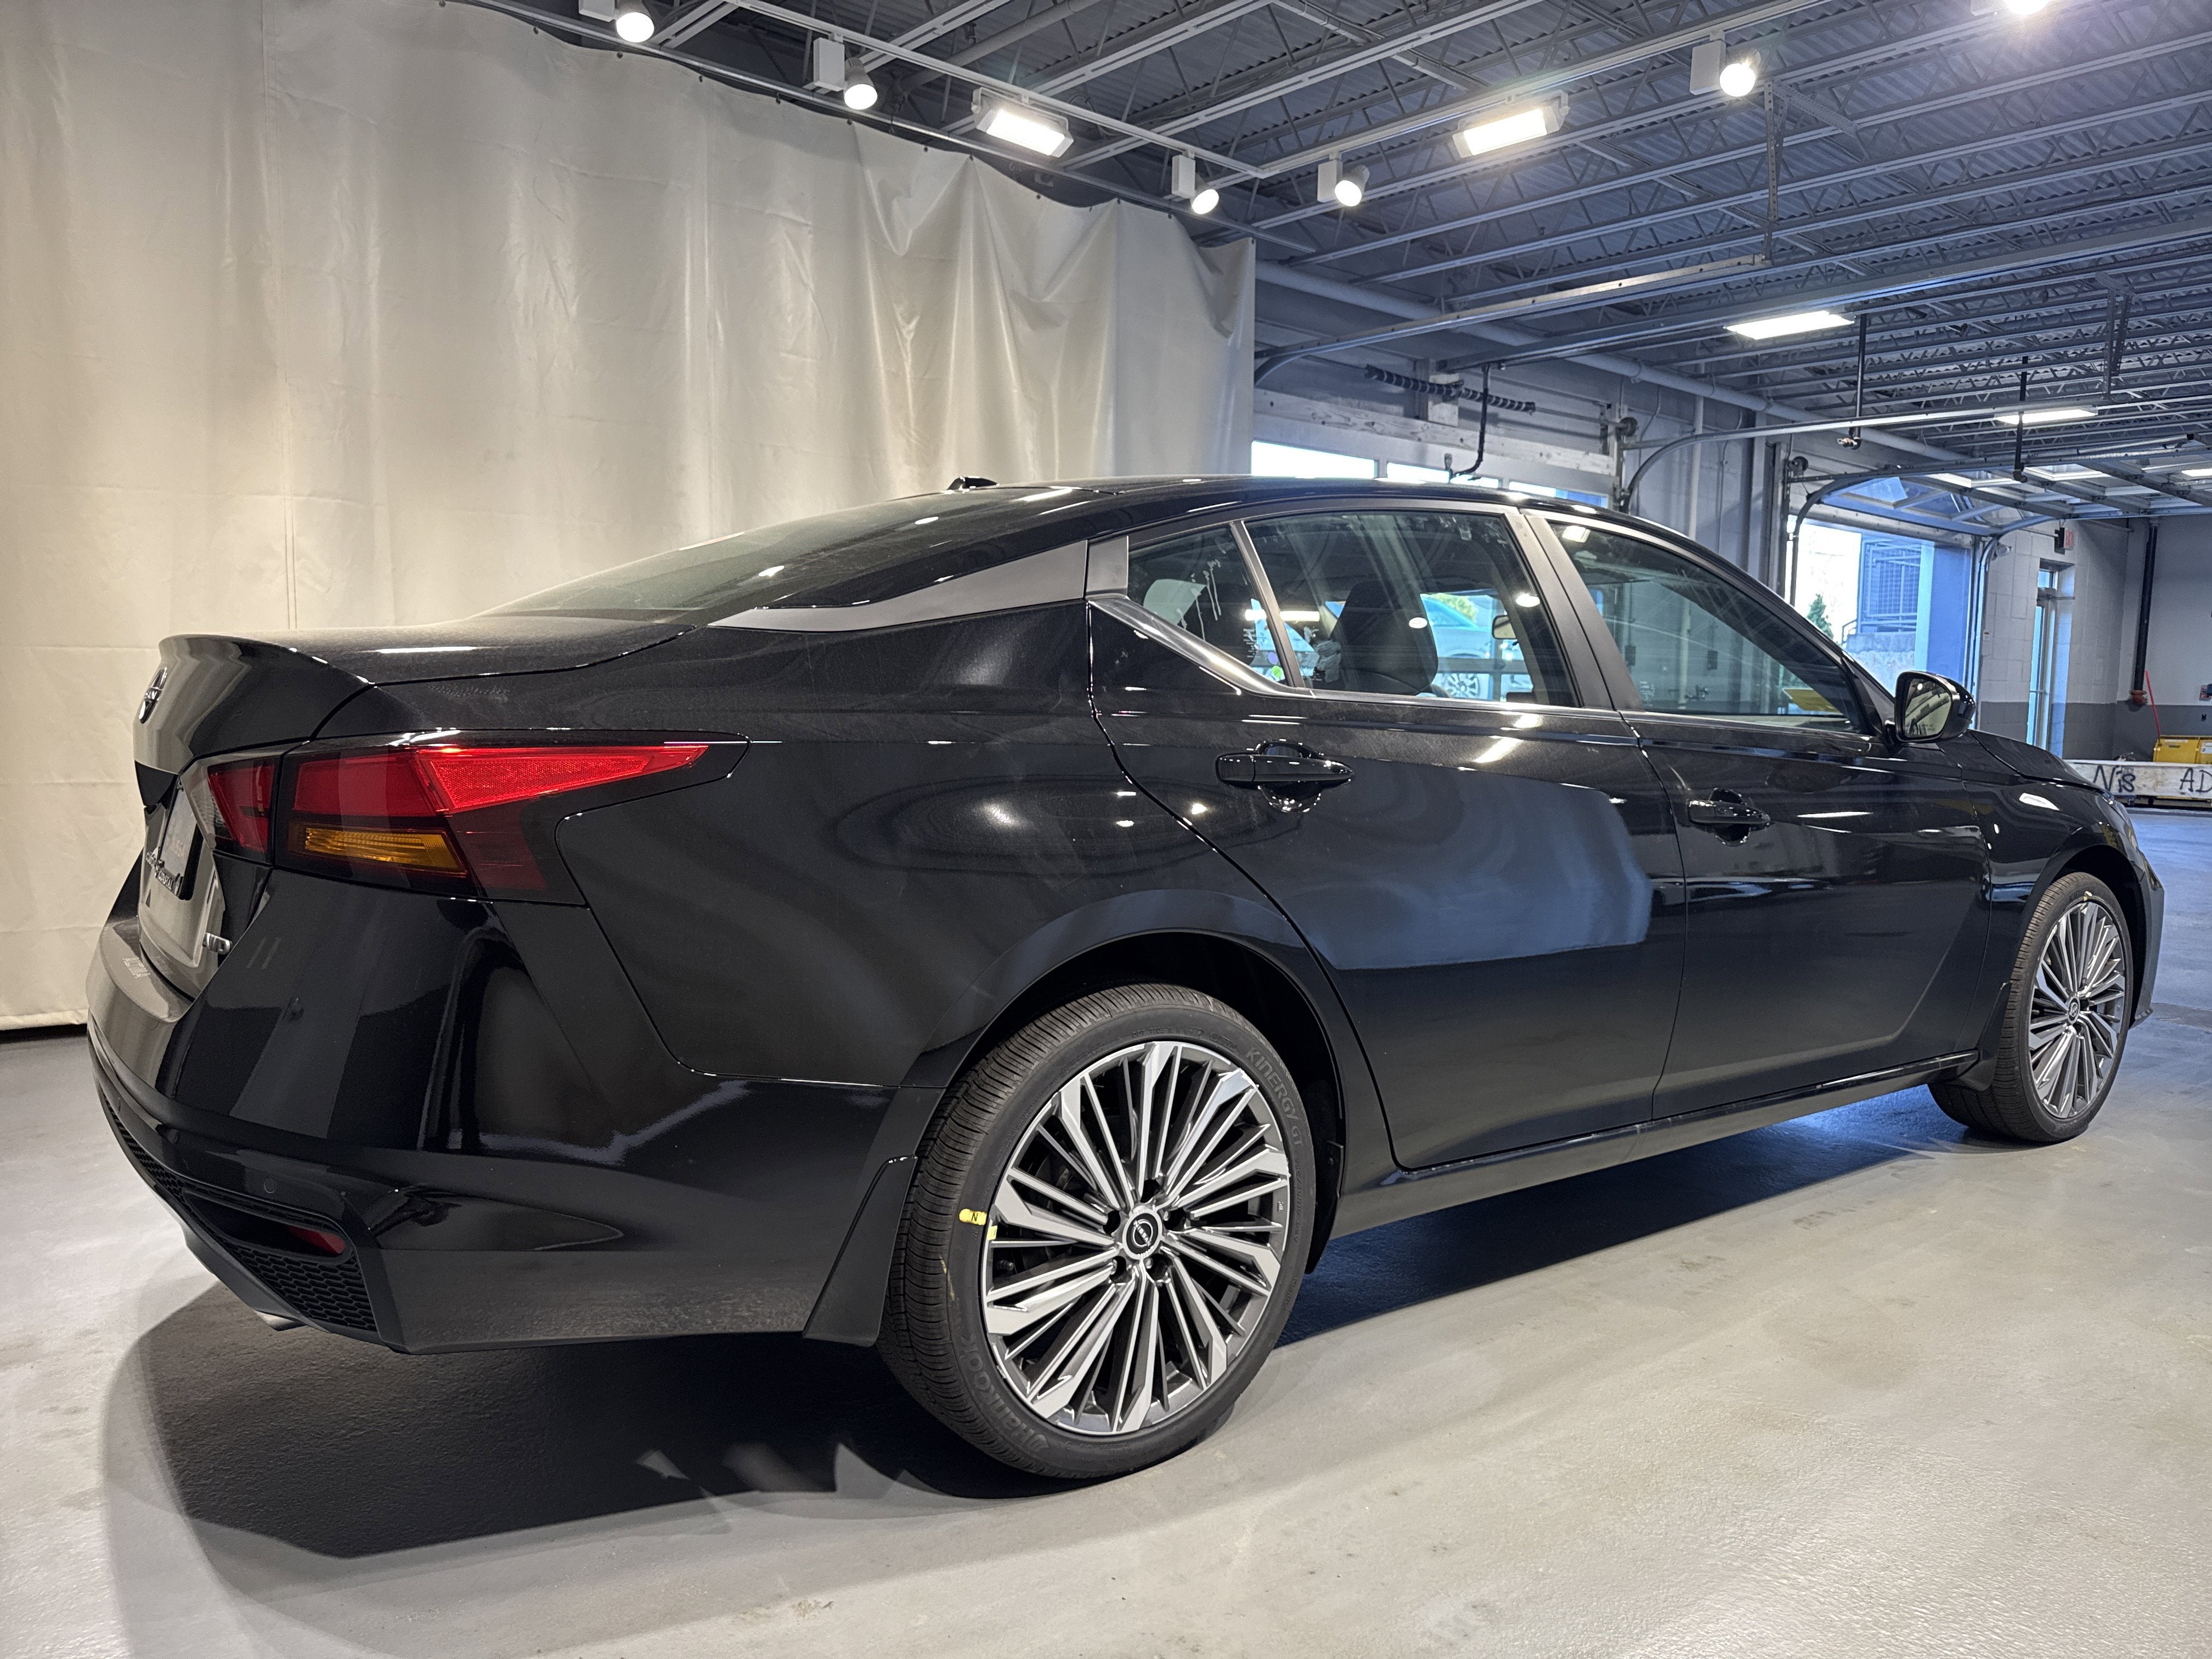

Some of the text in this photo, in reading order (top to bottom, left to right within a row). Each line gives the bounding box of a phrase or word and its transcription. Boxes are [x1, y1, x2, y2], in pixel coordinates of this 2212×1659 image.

[1246, 1046, 1304, 1146] KINERGY GT
[971, 1212, 979, 1222] N
[1133, 1220, 1152, 1246] NISSAN
